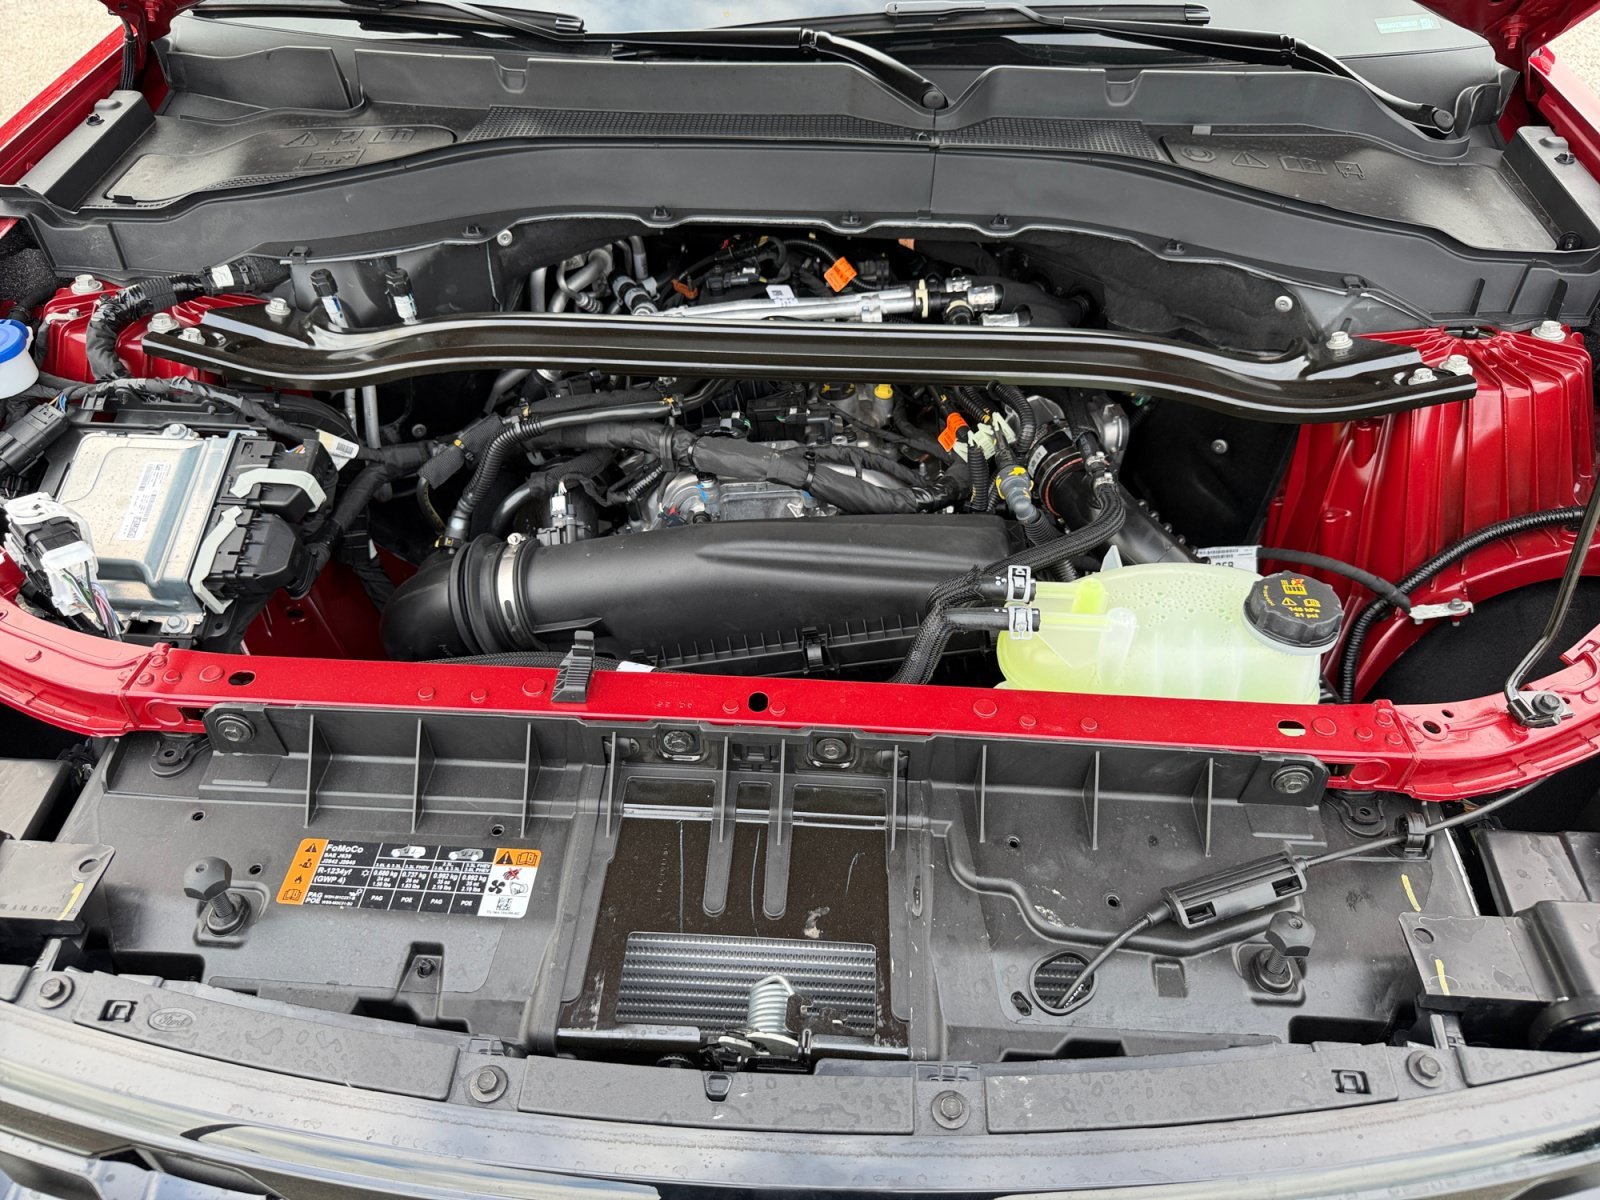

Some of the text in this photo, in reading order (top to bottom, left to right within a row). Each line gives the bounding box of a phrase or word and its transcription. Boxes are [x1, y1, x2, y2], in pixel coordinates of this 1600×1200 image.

[326, 844, 364, 853] FoMoCo
[317, 867, 353, 876] R-1234yf
[390, 870, 399, 878] kg
[314, 875, 337, 883] (GWP
[418, 872, 427, 880] kg
[450, 873, 458, 881] kg
[478, 875, 487, 883] kg
